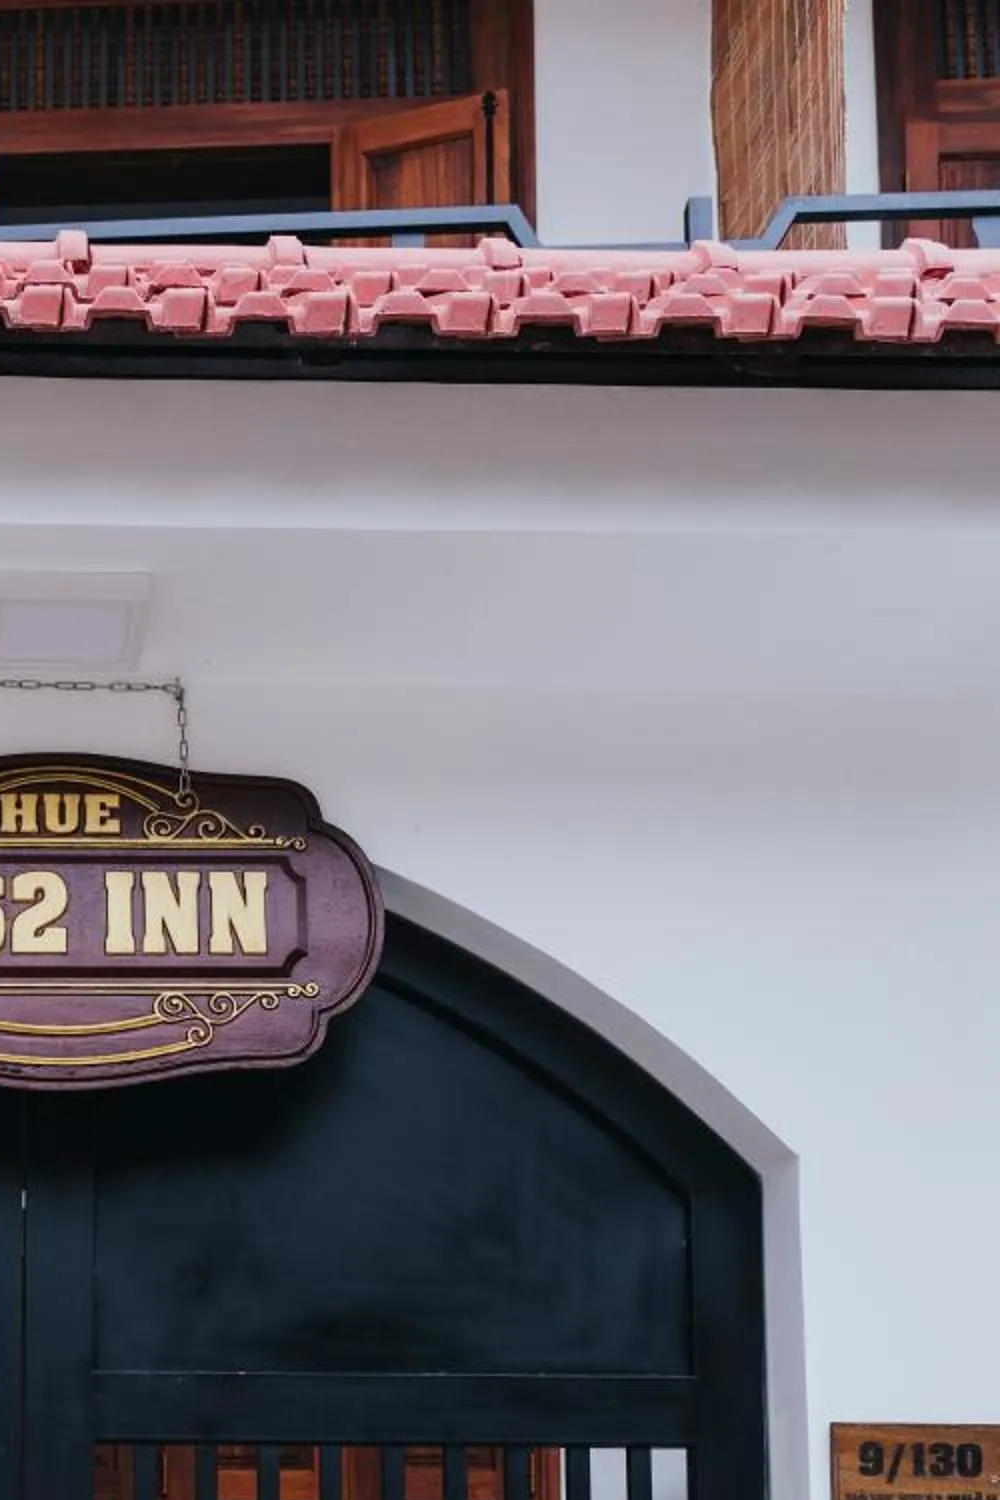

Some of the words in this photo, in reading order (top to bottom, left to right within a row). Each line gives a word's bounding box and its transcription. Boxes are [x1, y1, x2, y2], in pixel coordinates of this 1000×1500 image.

[0, 792, 121, 835] HUE
[103, 869, 270, 957] INN
[857, 1440, 983, 1484] 9/130
